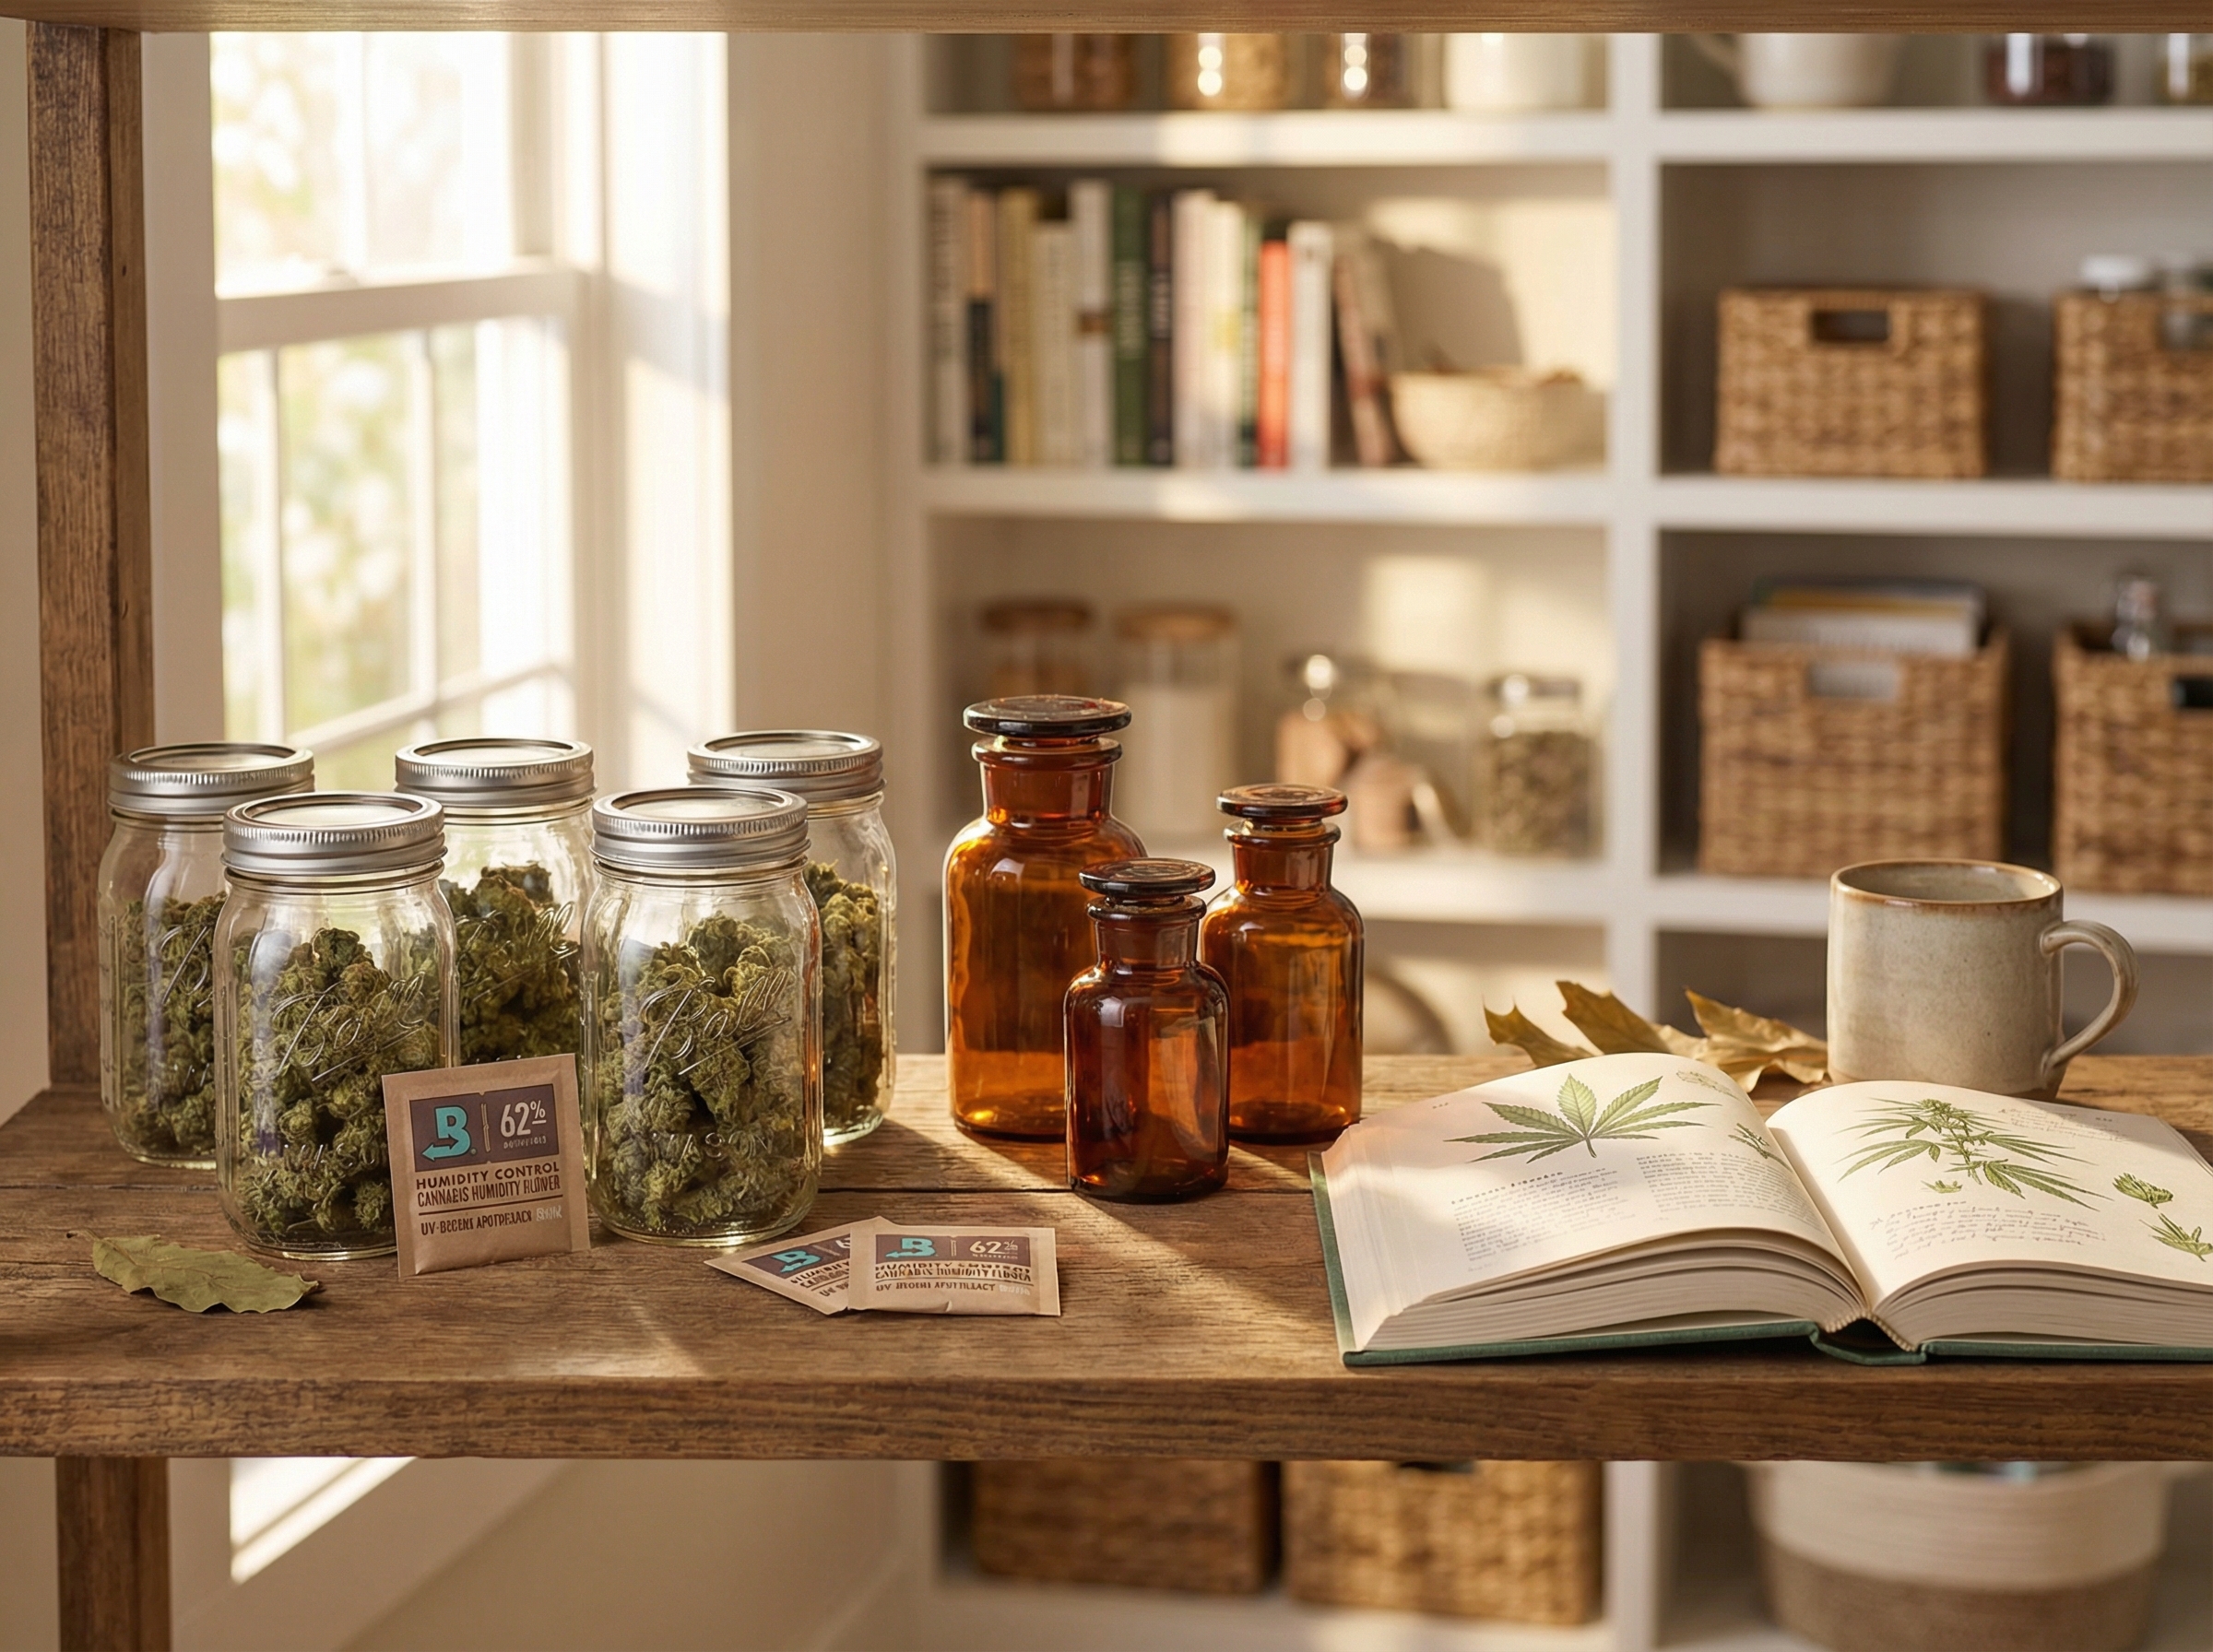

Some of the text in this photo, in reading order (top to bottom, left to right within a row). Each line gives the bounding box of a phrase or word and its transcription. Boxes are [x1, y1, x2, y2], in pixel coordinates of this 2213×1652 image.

[500, 1100, 547, 1138] 62%
[416, 1162, 560, 1190] HUMIDITY CONTROL
[471, 1180, 521, 1201] HUMIDITY
